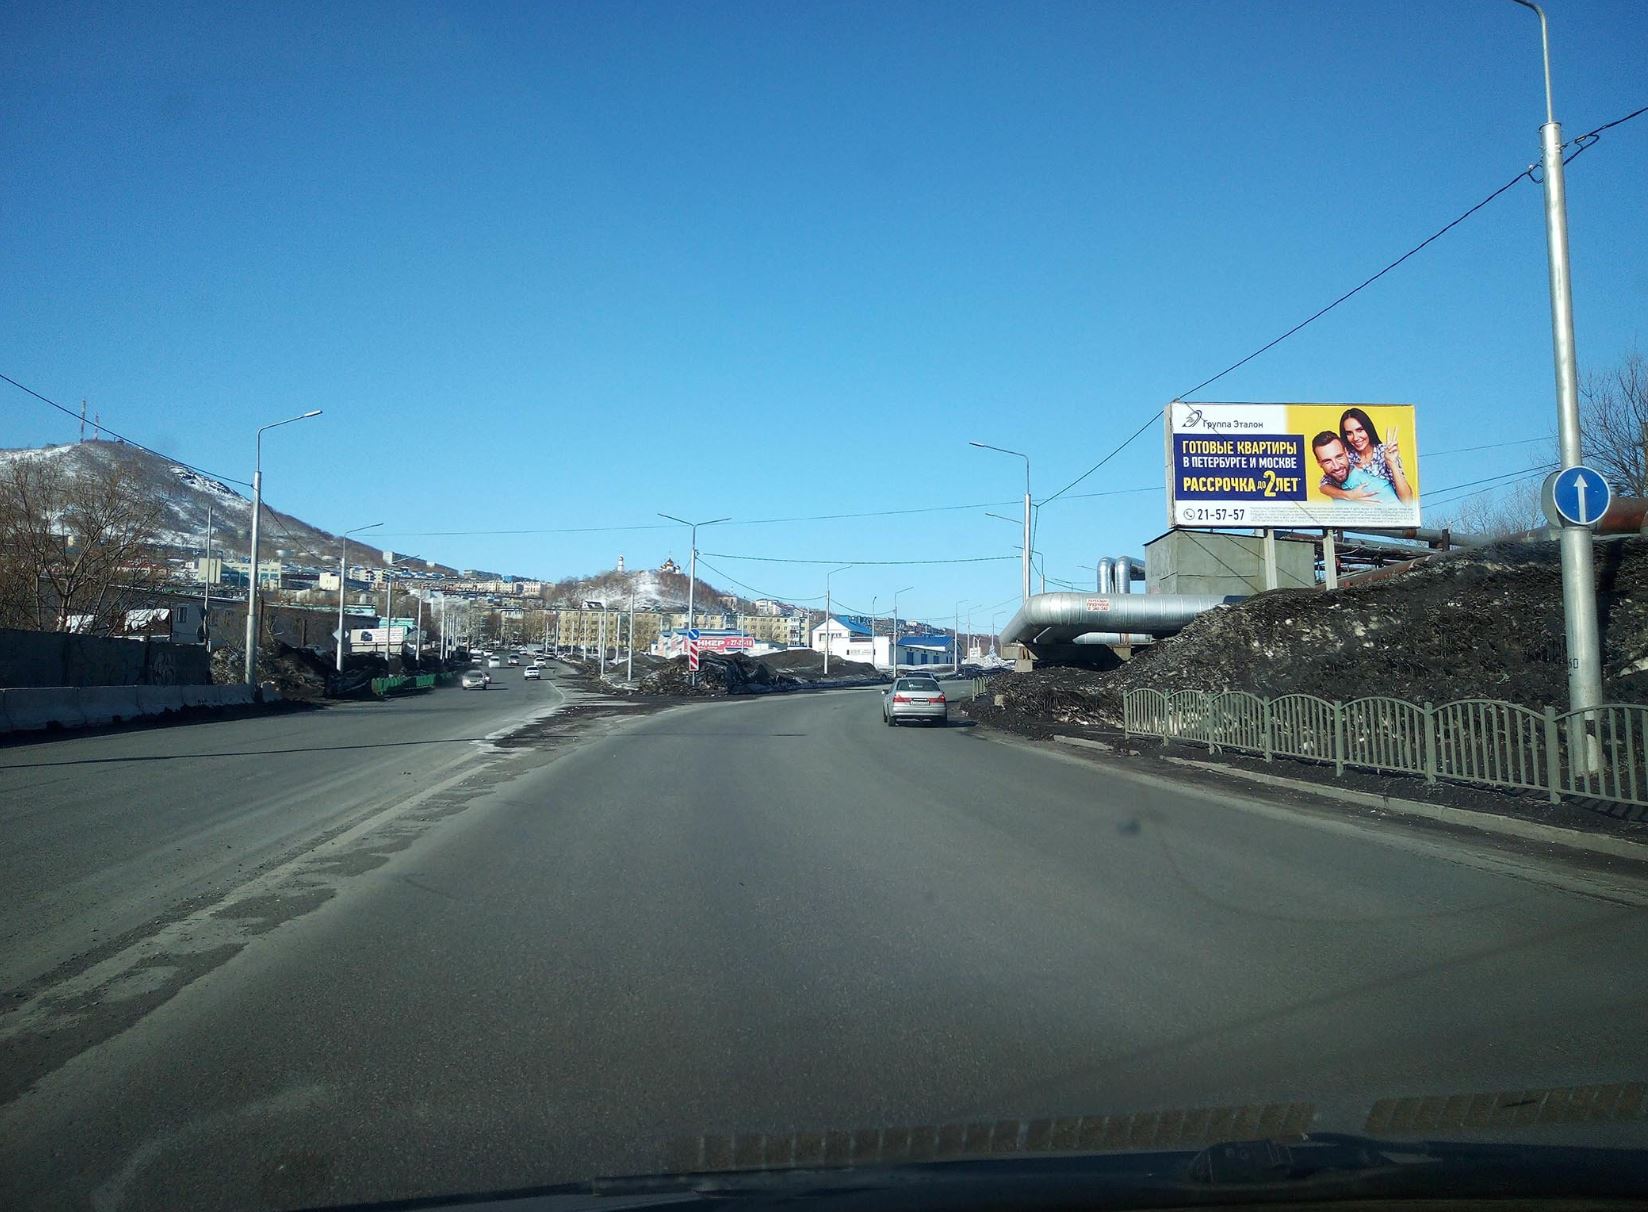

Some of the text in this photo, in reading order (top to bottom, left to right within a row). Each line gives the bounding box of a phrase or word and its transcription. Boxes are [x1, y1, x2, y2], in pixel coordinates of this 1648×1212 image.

[1203, 419, 1263, 429] Группа Эталон
[1182, 440, 1297, 455] ГОТОВЫЕ КВАРТИРЫ
[1183, 457, 1297, 468] В ПЕТЕРБУРГЕ И МОСКВЕ
[1183, 477, 1256, 492] РАССРОЧКА
[1263, 470, 1277, 497] 2
[1197, 508, 1245, 520] 21-57-57
